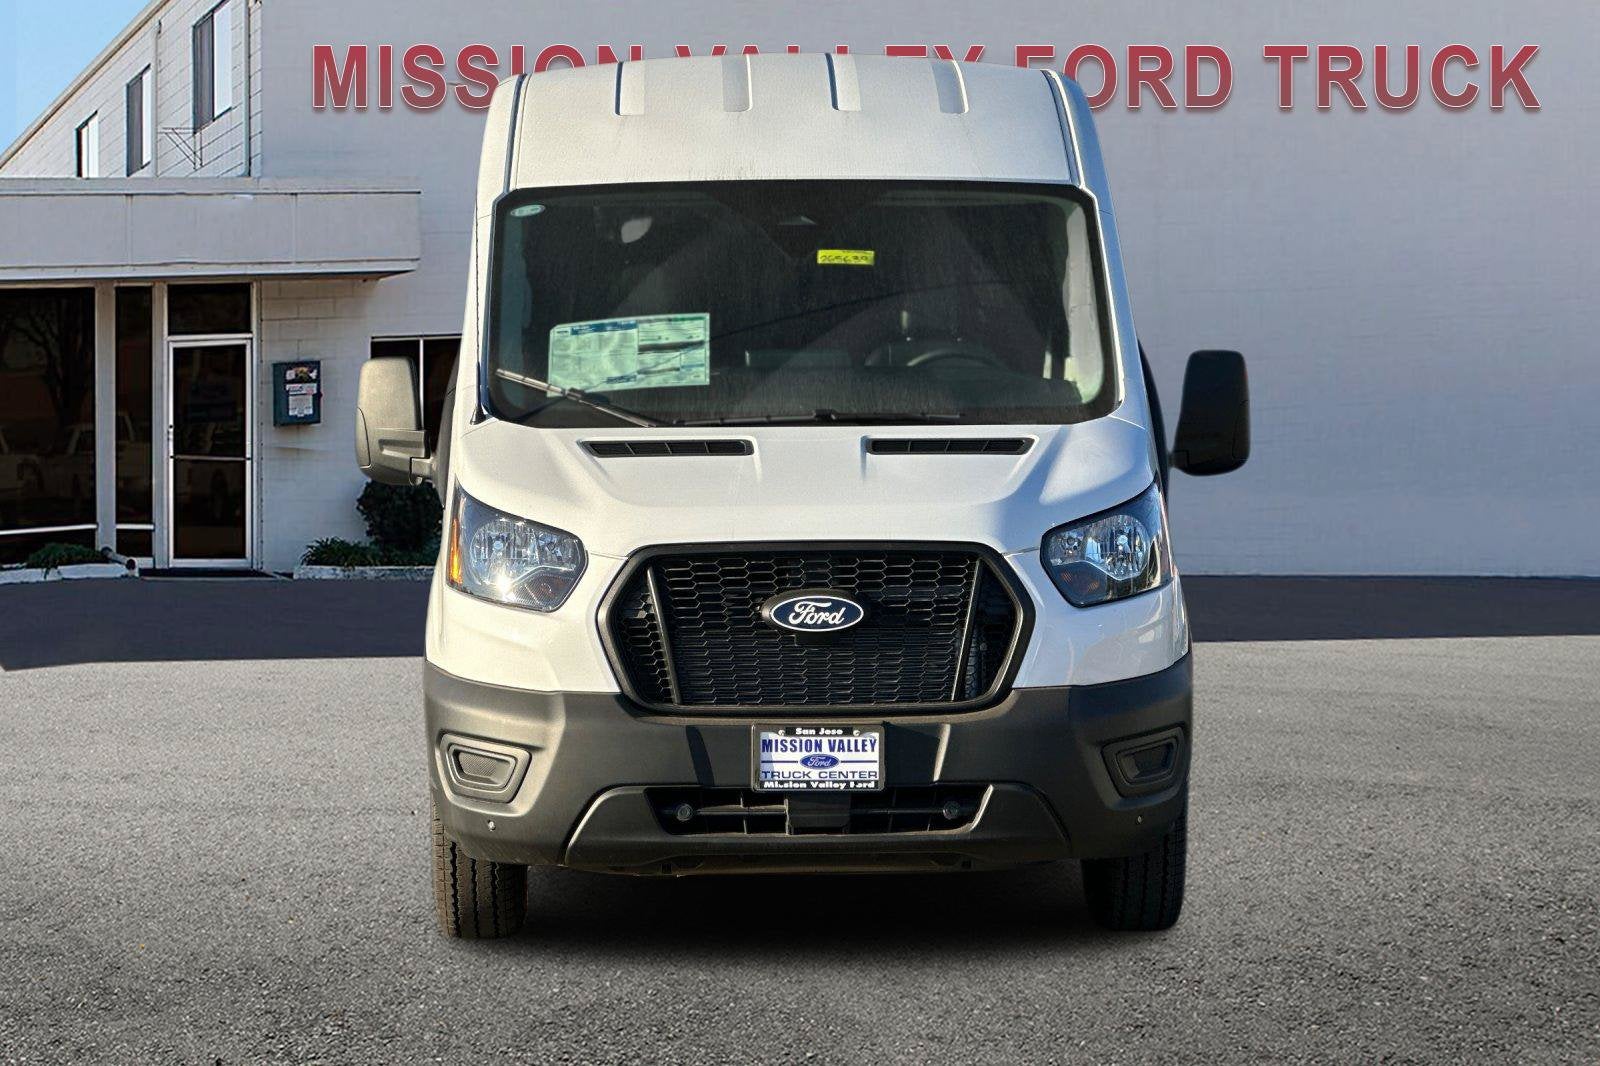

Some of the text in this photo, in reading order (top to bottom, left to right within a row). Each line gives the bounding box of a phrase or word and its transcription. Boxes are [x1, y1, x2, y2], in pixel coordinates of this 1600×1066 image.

[311, 44, 643, 109] MISS
[1263, 44, 1541, 108] TRUCK
[788, 601, 846, 624] Ford
[795, 727, 844, 735] San Jose
[761, 738, 877, 753] MISSION VALLEY
[807, 756, 831, 767] Ford
[761, 771, 877, 779] TRUCK CENTER
[810, 781, 847, 790] Valley
